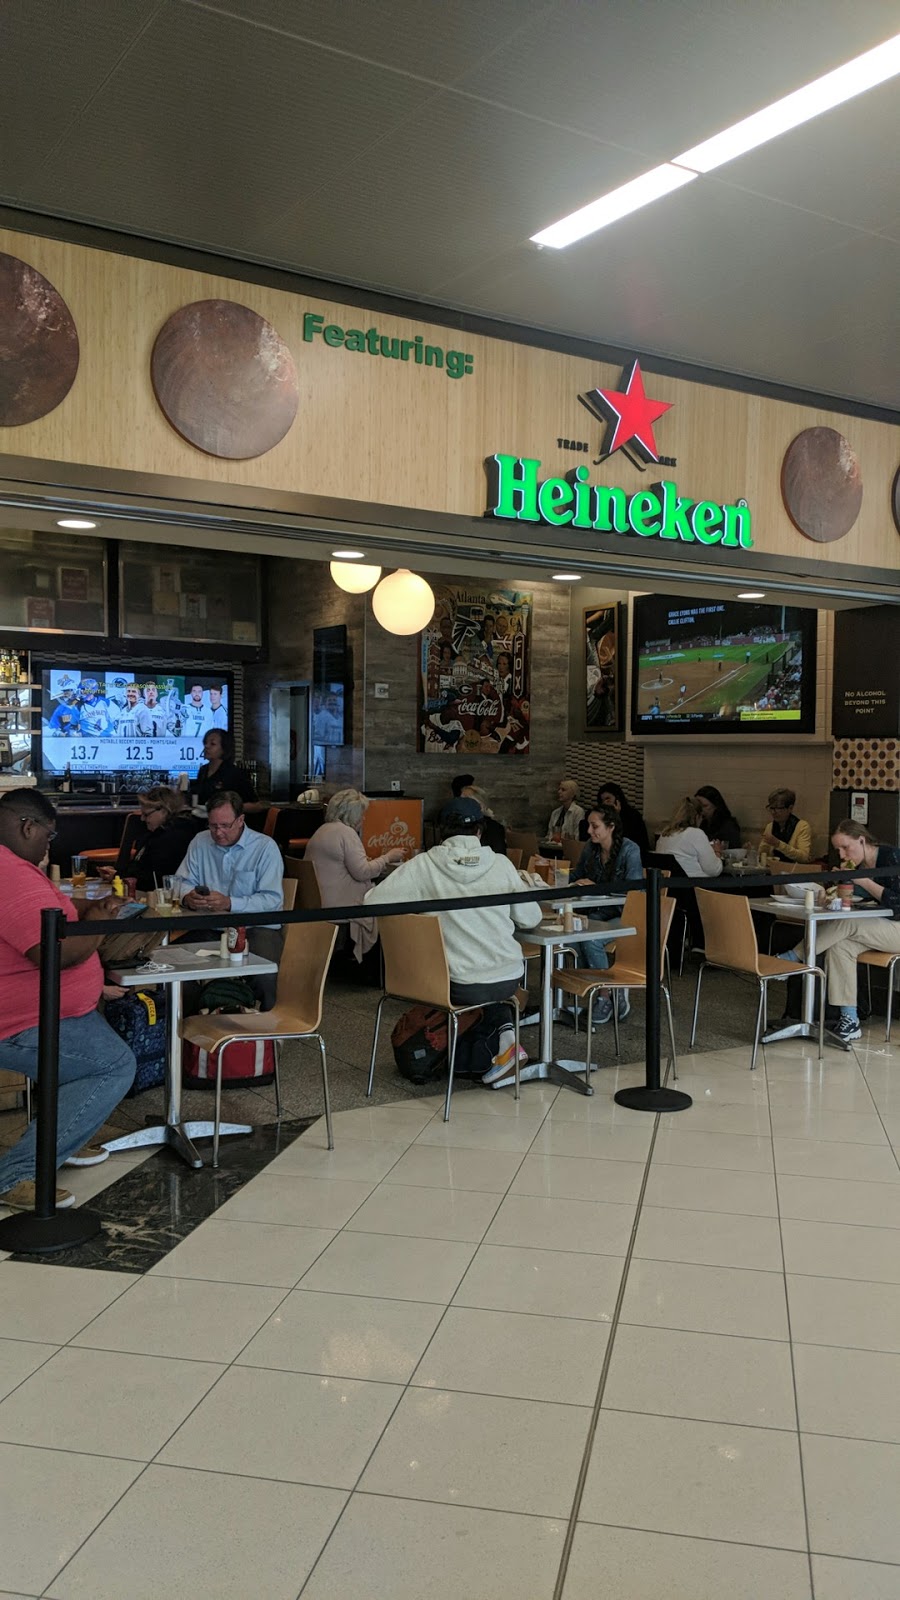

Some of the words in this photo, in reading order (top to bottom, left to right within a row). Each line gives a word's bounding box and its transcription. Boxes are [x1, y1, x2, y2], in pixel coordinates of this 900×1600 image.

[303, 312, 474, 379] Featuring:
[557, 438, 589, 453] TRADE
[657, 455, 677, 467] ARK
[490, 453, 754, 549] Heineken
[456, 591, 486, 604] Atlanta
[195, 722, 202, 738] 7
[71, 745, 99, 760] 13.7
[126, 746, 153, 760] 12.5
[367, 831, 416, 849] atlanta
